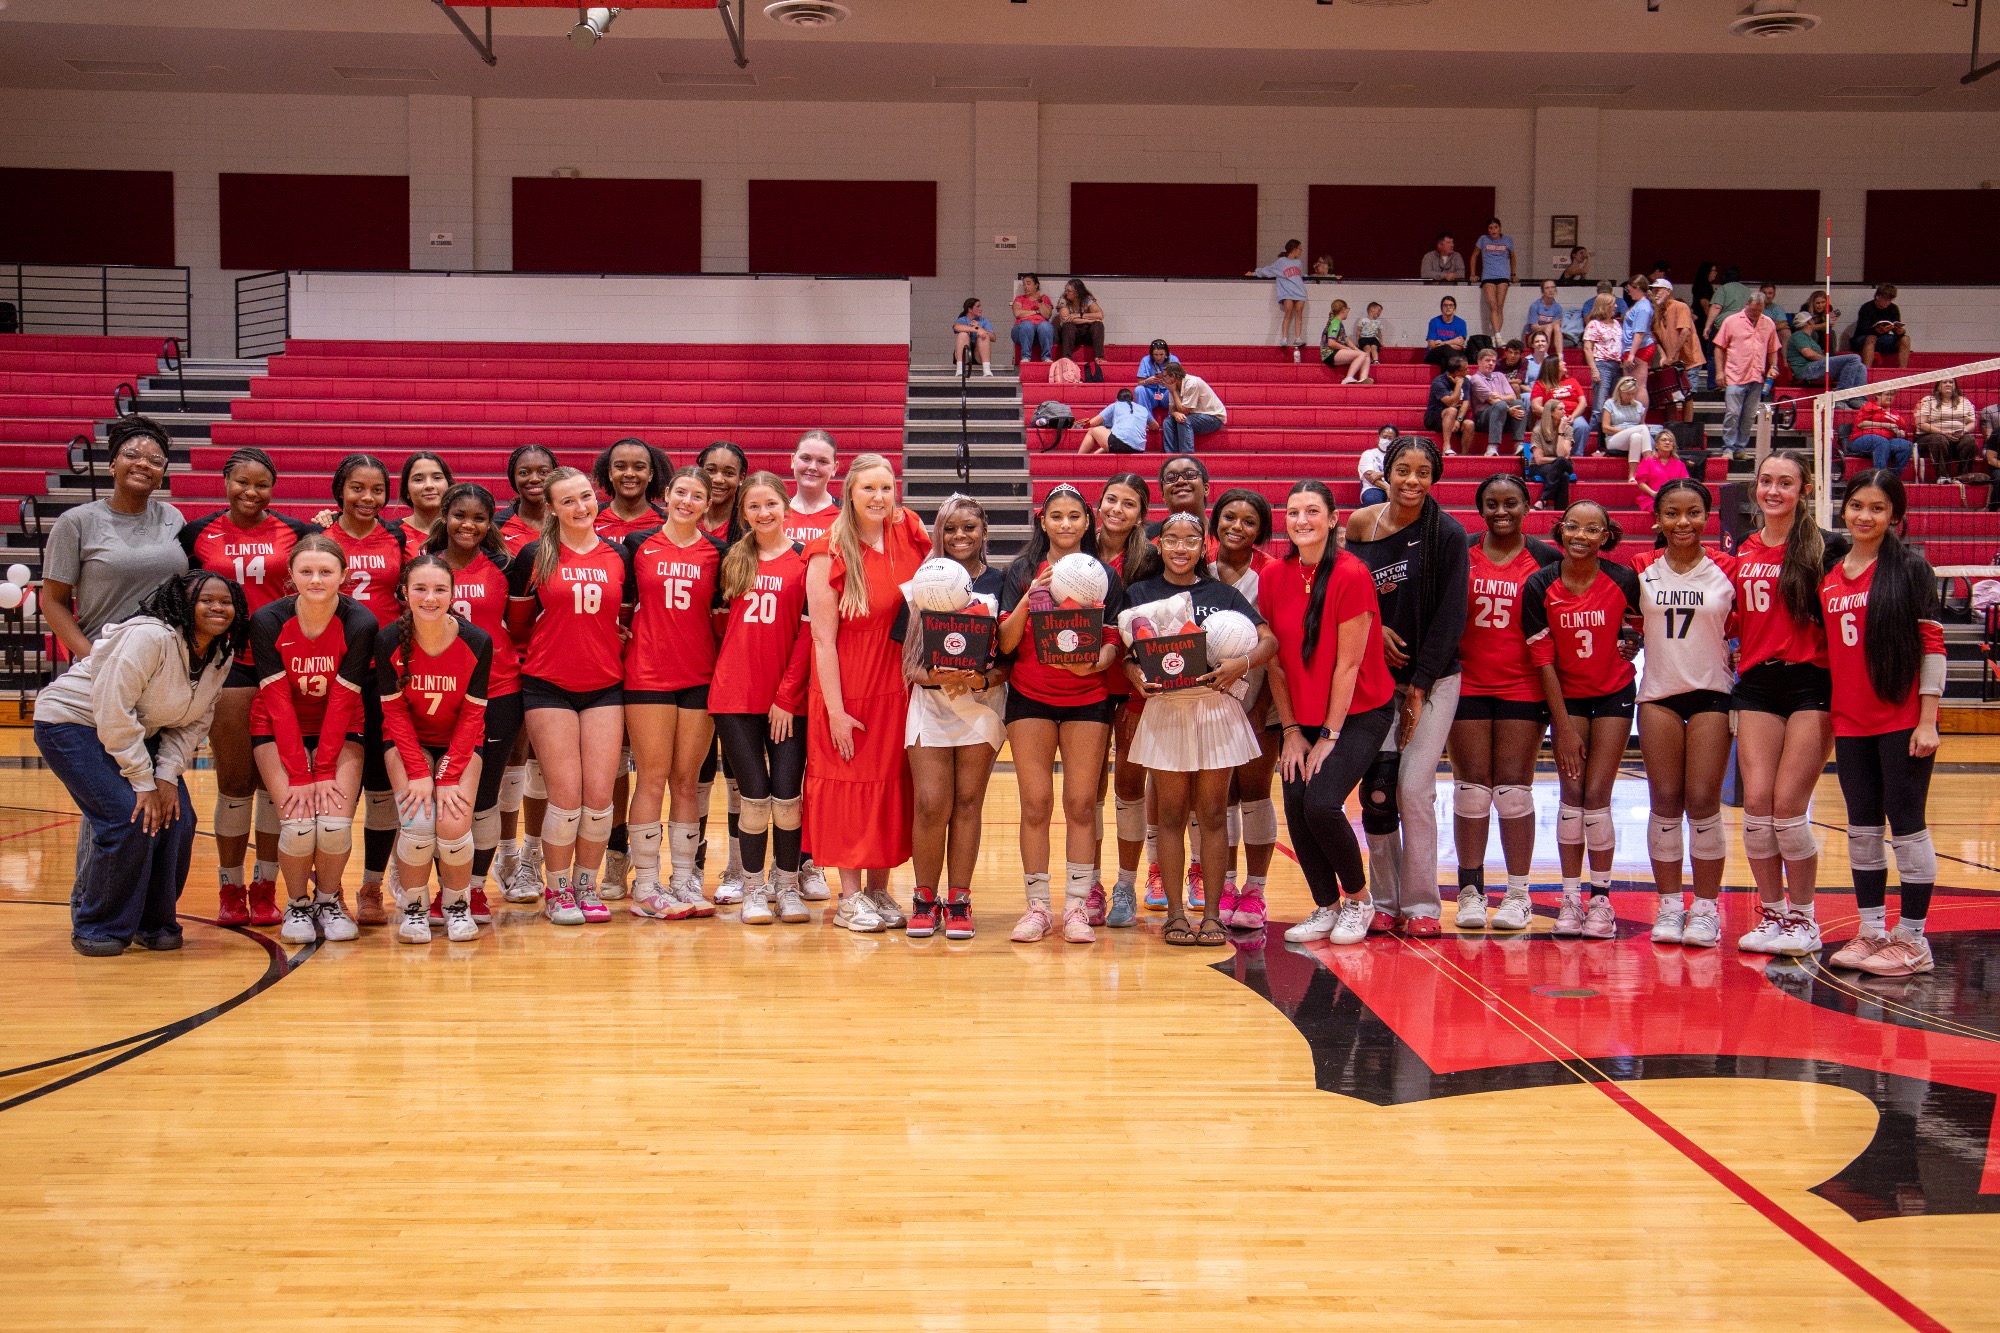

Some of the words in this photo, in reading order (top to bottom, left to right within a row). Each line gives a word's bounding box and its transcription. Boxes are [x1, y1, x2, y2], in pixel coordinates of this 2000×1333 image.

[783, 527, 826, 541] CLINTON
[225, 543, 274, 556] CLINTON
[233, 556, 266, 585] 14
[348, 555, 386, 570] INTON
[657, 561, 701, 580] CLINTON
[1374, 563, 1408, 581] INTON
[1738, 562, 1782, 578] CLINTON
[350, 570, 372, 601] 2
[561, 567, 609, 584] CLINTON
[753, 574, 783, 592] INTON
[1376, 571, 1407, 587] LEYBALL
[454, 583, 485, 599] NTON
[663, 577, 693, 611] 15
[1473, 578, 1518, 598] CLINTON
[1656, 590, 1704, 606] CLINTON
[1742, 579, 1771, 613] 16
[571, 582, 603, 615] 18
[743, 591, 778, 625] 20
[1827, 590, 1869, 614] CLINTON
[1474, 595, 1513, 629] 25
[1560, 609, 1606, 629] CLINTON
[925, 615, 989, 635] Kimberlee
[1663, 607, 1696, 639] 17
[1840, 612, 1859, 647] 6
[1145, 639, 1196, 658] Morgan
[1574, 629, 1593, 659] 3
[291, 655, 335, 674] CLINTON
[297, 674, 328, 698] 13
[411, 674, 457, 692] CLINTON
[424, 692, 443, 716] 7
